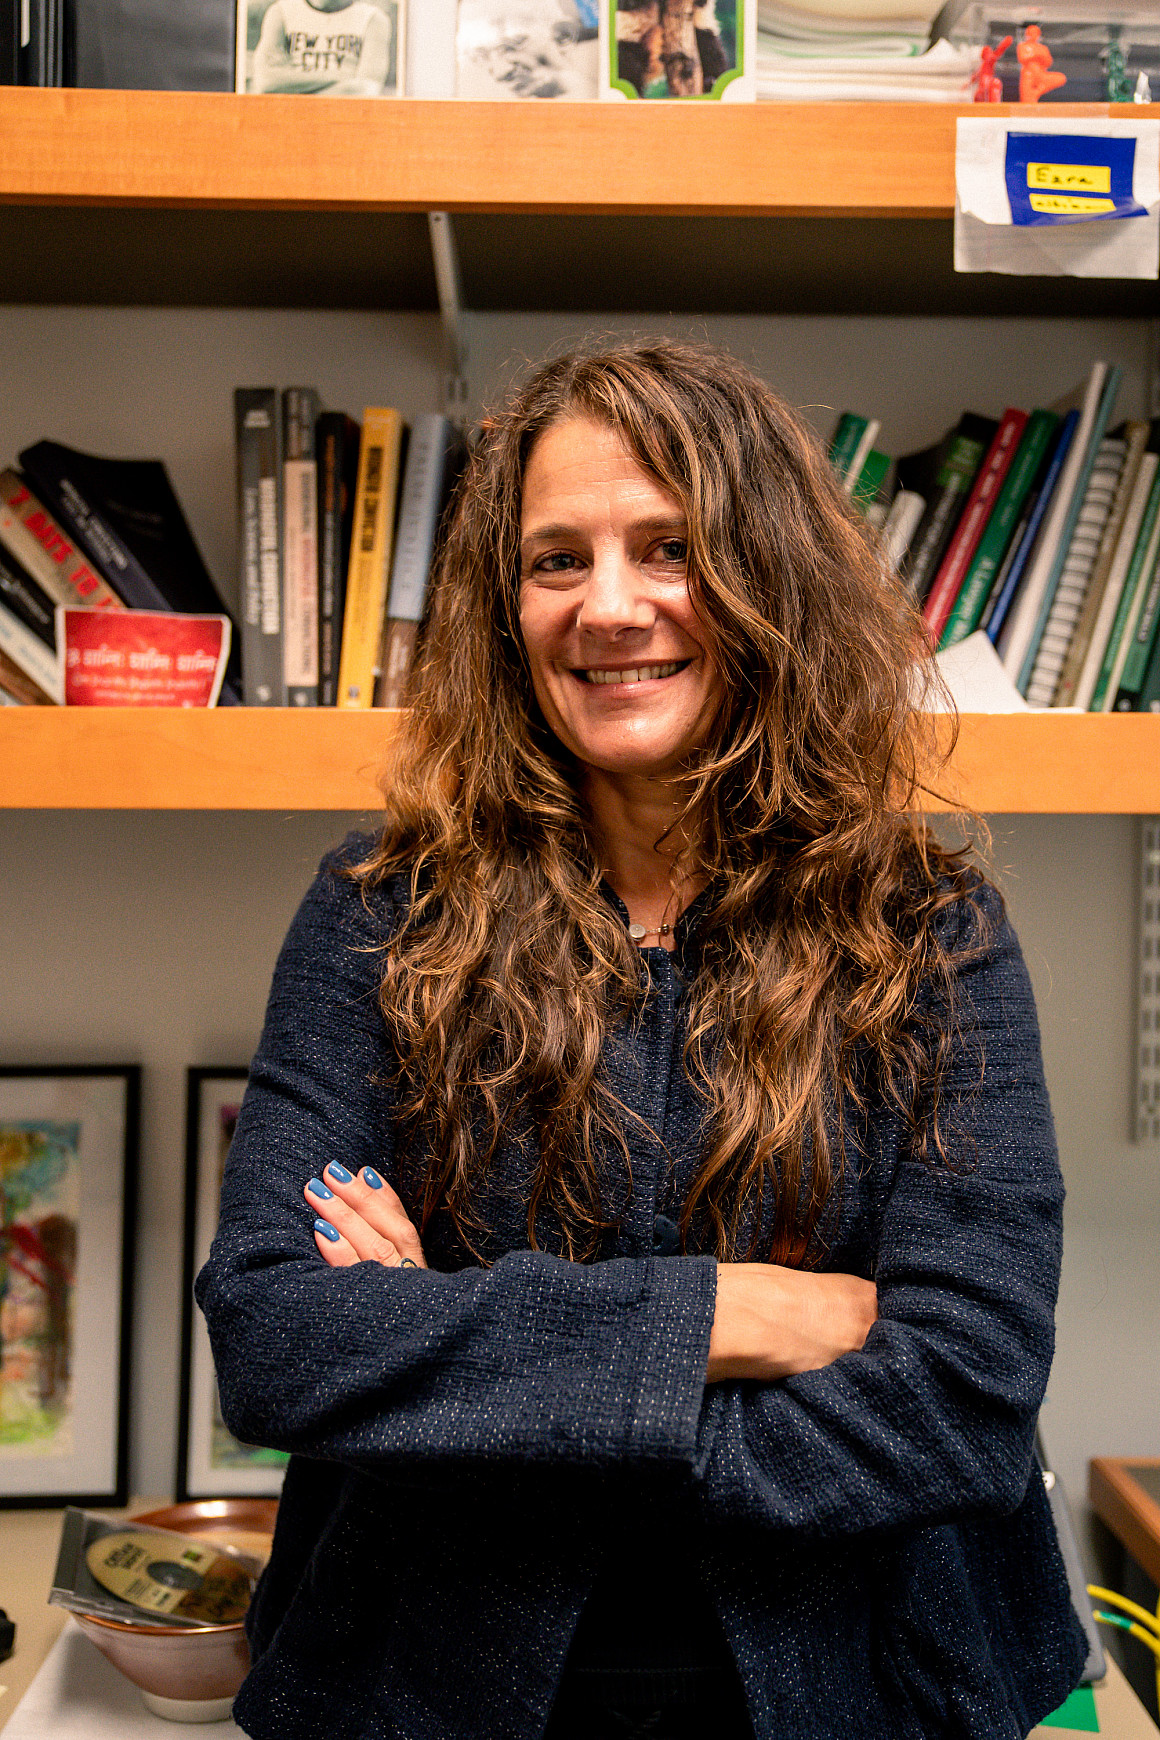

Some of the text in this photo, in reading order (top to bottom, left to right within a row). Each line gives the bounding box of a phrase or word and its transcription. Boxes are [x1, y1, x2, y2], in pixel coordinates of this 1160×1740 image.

[285, 32, 319, 54] NEW
[302, 51, 345, 71] CITY
[24, 511, 73, 564] DAYS
[69, 564, 99, 597] TO
